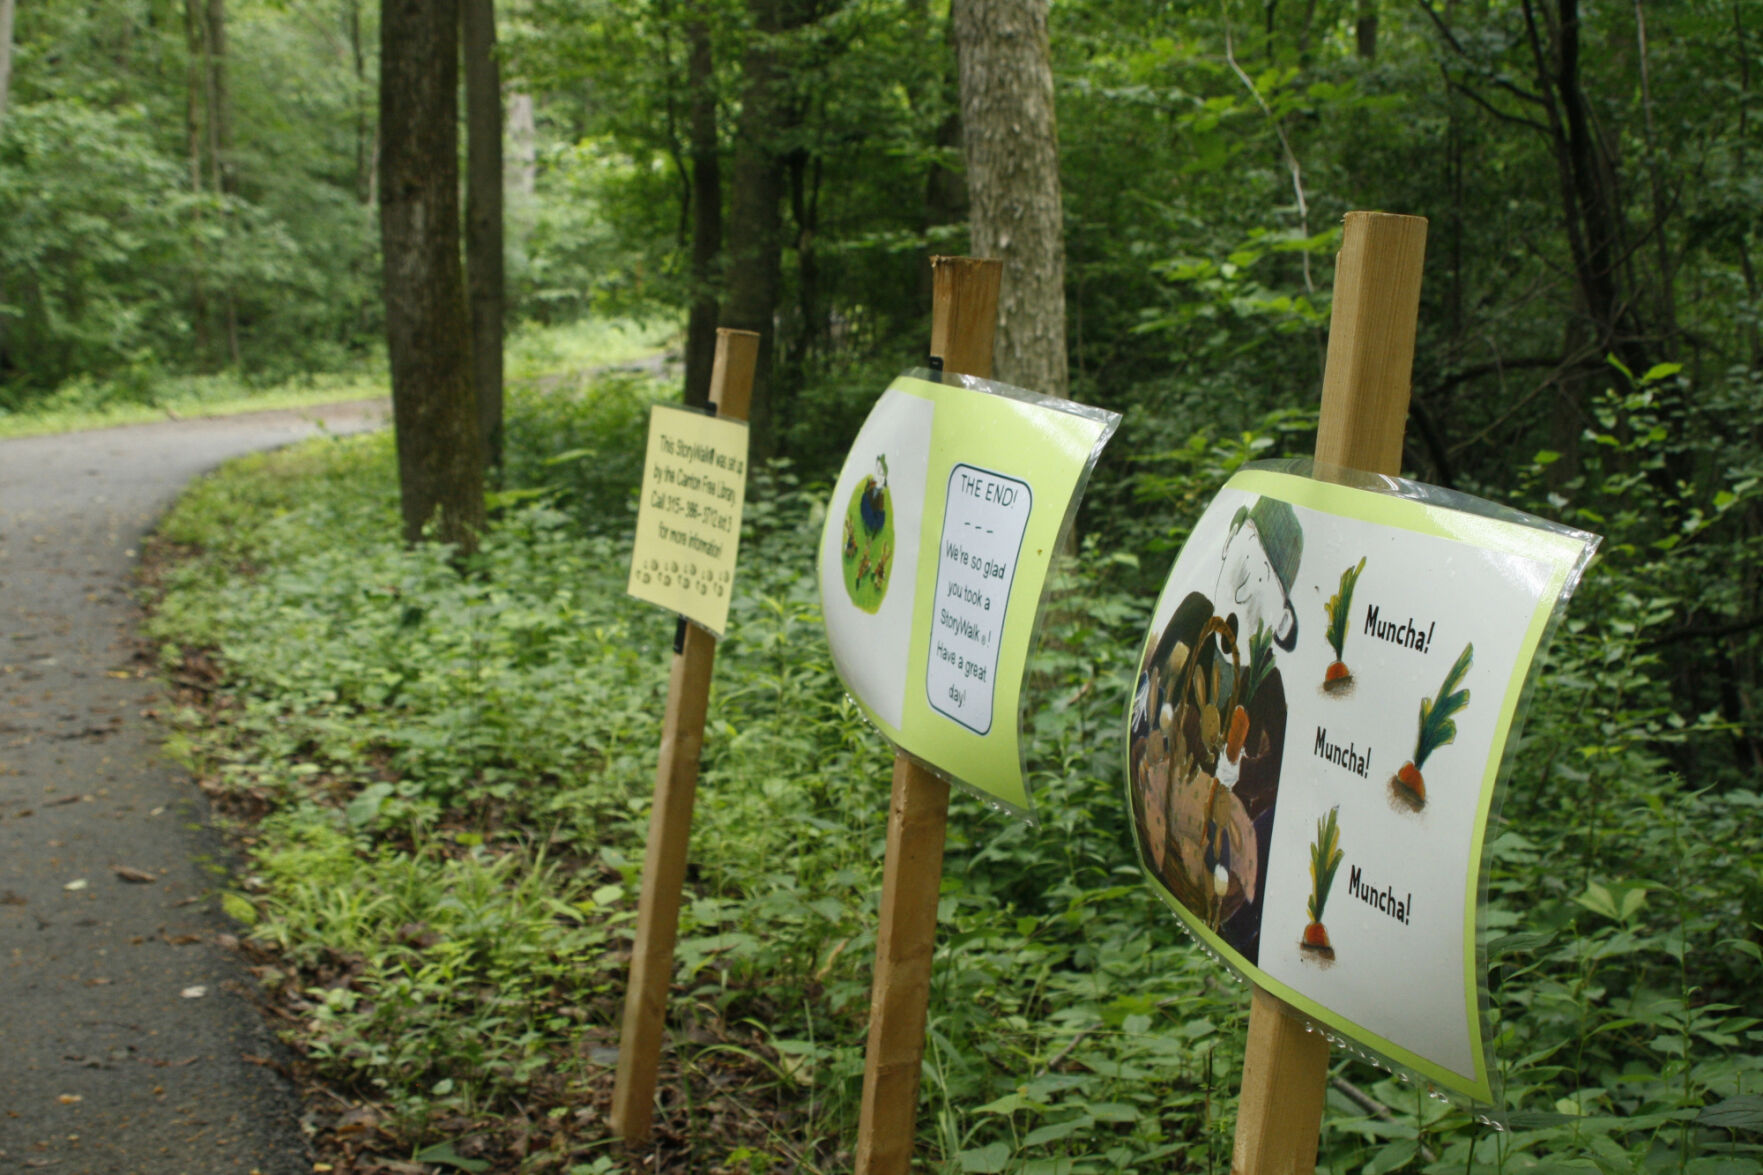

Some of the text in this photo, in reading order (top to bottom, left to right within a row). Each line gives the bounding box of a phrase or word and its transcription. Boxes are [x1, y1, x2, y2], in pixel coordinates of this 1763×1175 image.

[660, 433, 674, 455] This
[653, 463, 662, 485] by
[664, 465, 675, 484] the
[651, 490, 665, 510] Call
[961, 474, 1018, 509] THE END!
[659, 521, 669, 540] for
[669, 529, 686, 546] more
[945, 539, 1006, 580] We're so glad
[947, 580, 991, 611] you took a
[1364, 604, 1435, 653] Muncha!
[936, 640, 987, 683] Have a great
[948, 684, 966, 708] day!
[1314, 726, 1371, 779] Muncha!
[1348, 864, 1412, 926] Muncha!
